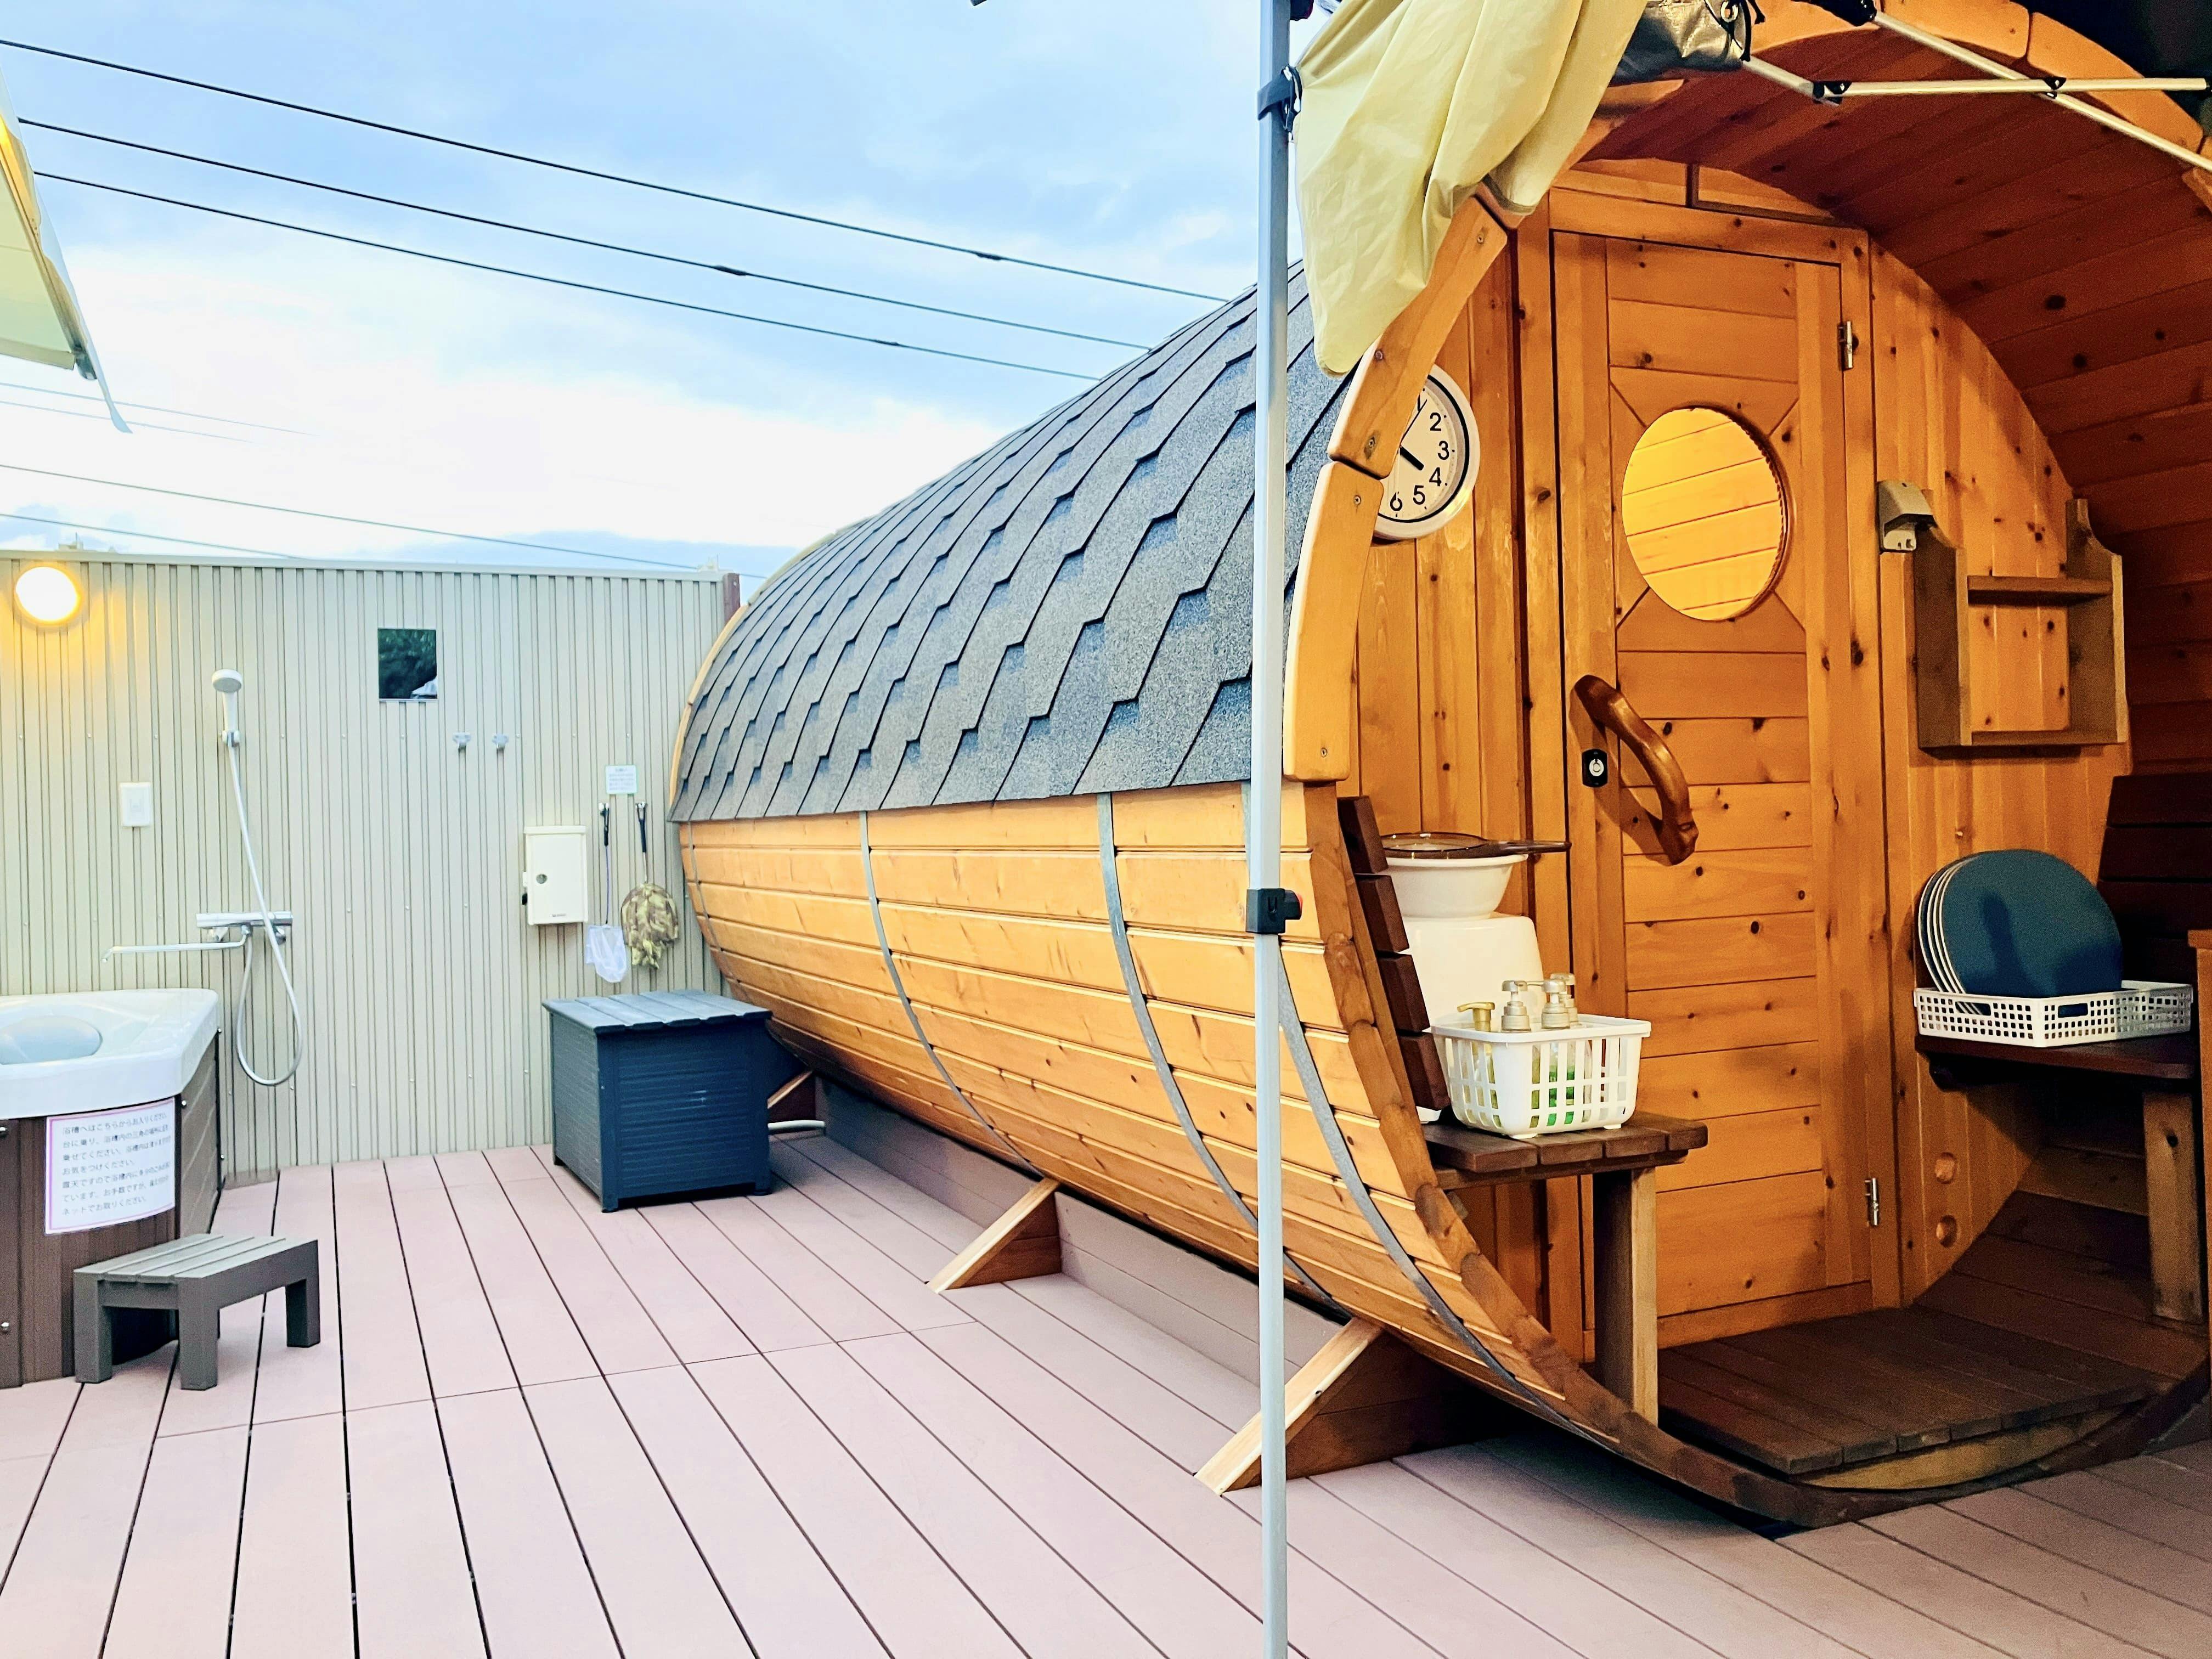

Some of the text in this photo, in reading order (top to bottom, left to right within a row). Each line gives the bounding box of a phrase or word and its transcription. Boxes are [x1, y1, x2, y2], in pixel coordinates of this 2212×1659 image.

[1430, 412, 1442, 431] 2
[1437, 441, 1449, 460] 3
[1429, 467, 1442, 487] 4
[1390, 492, 1403, 511] 6
[1413, 484, 1425, 505] 5
